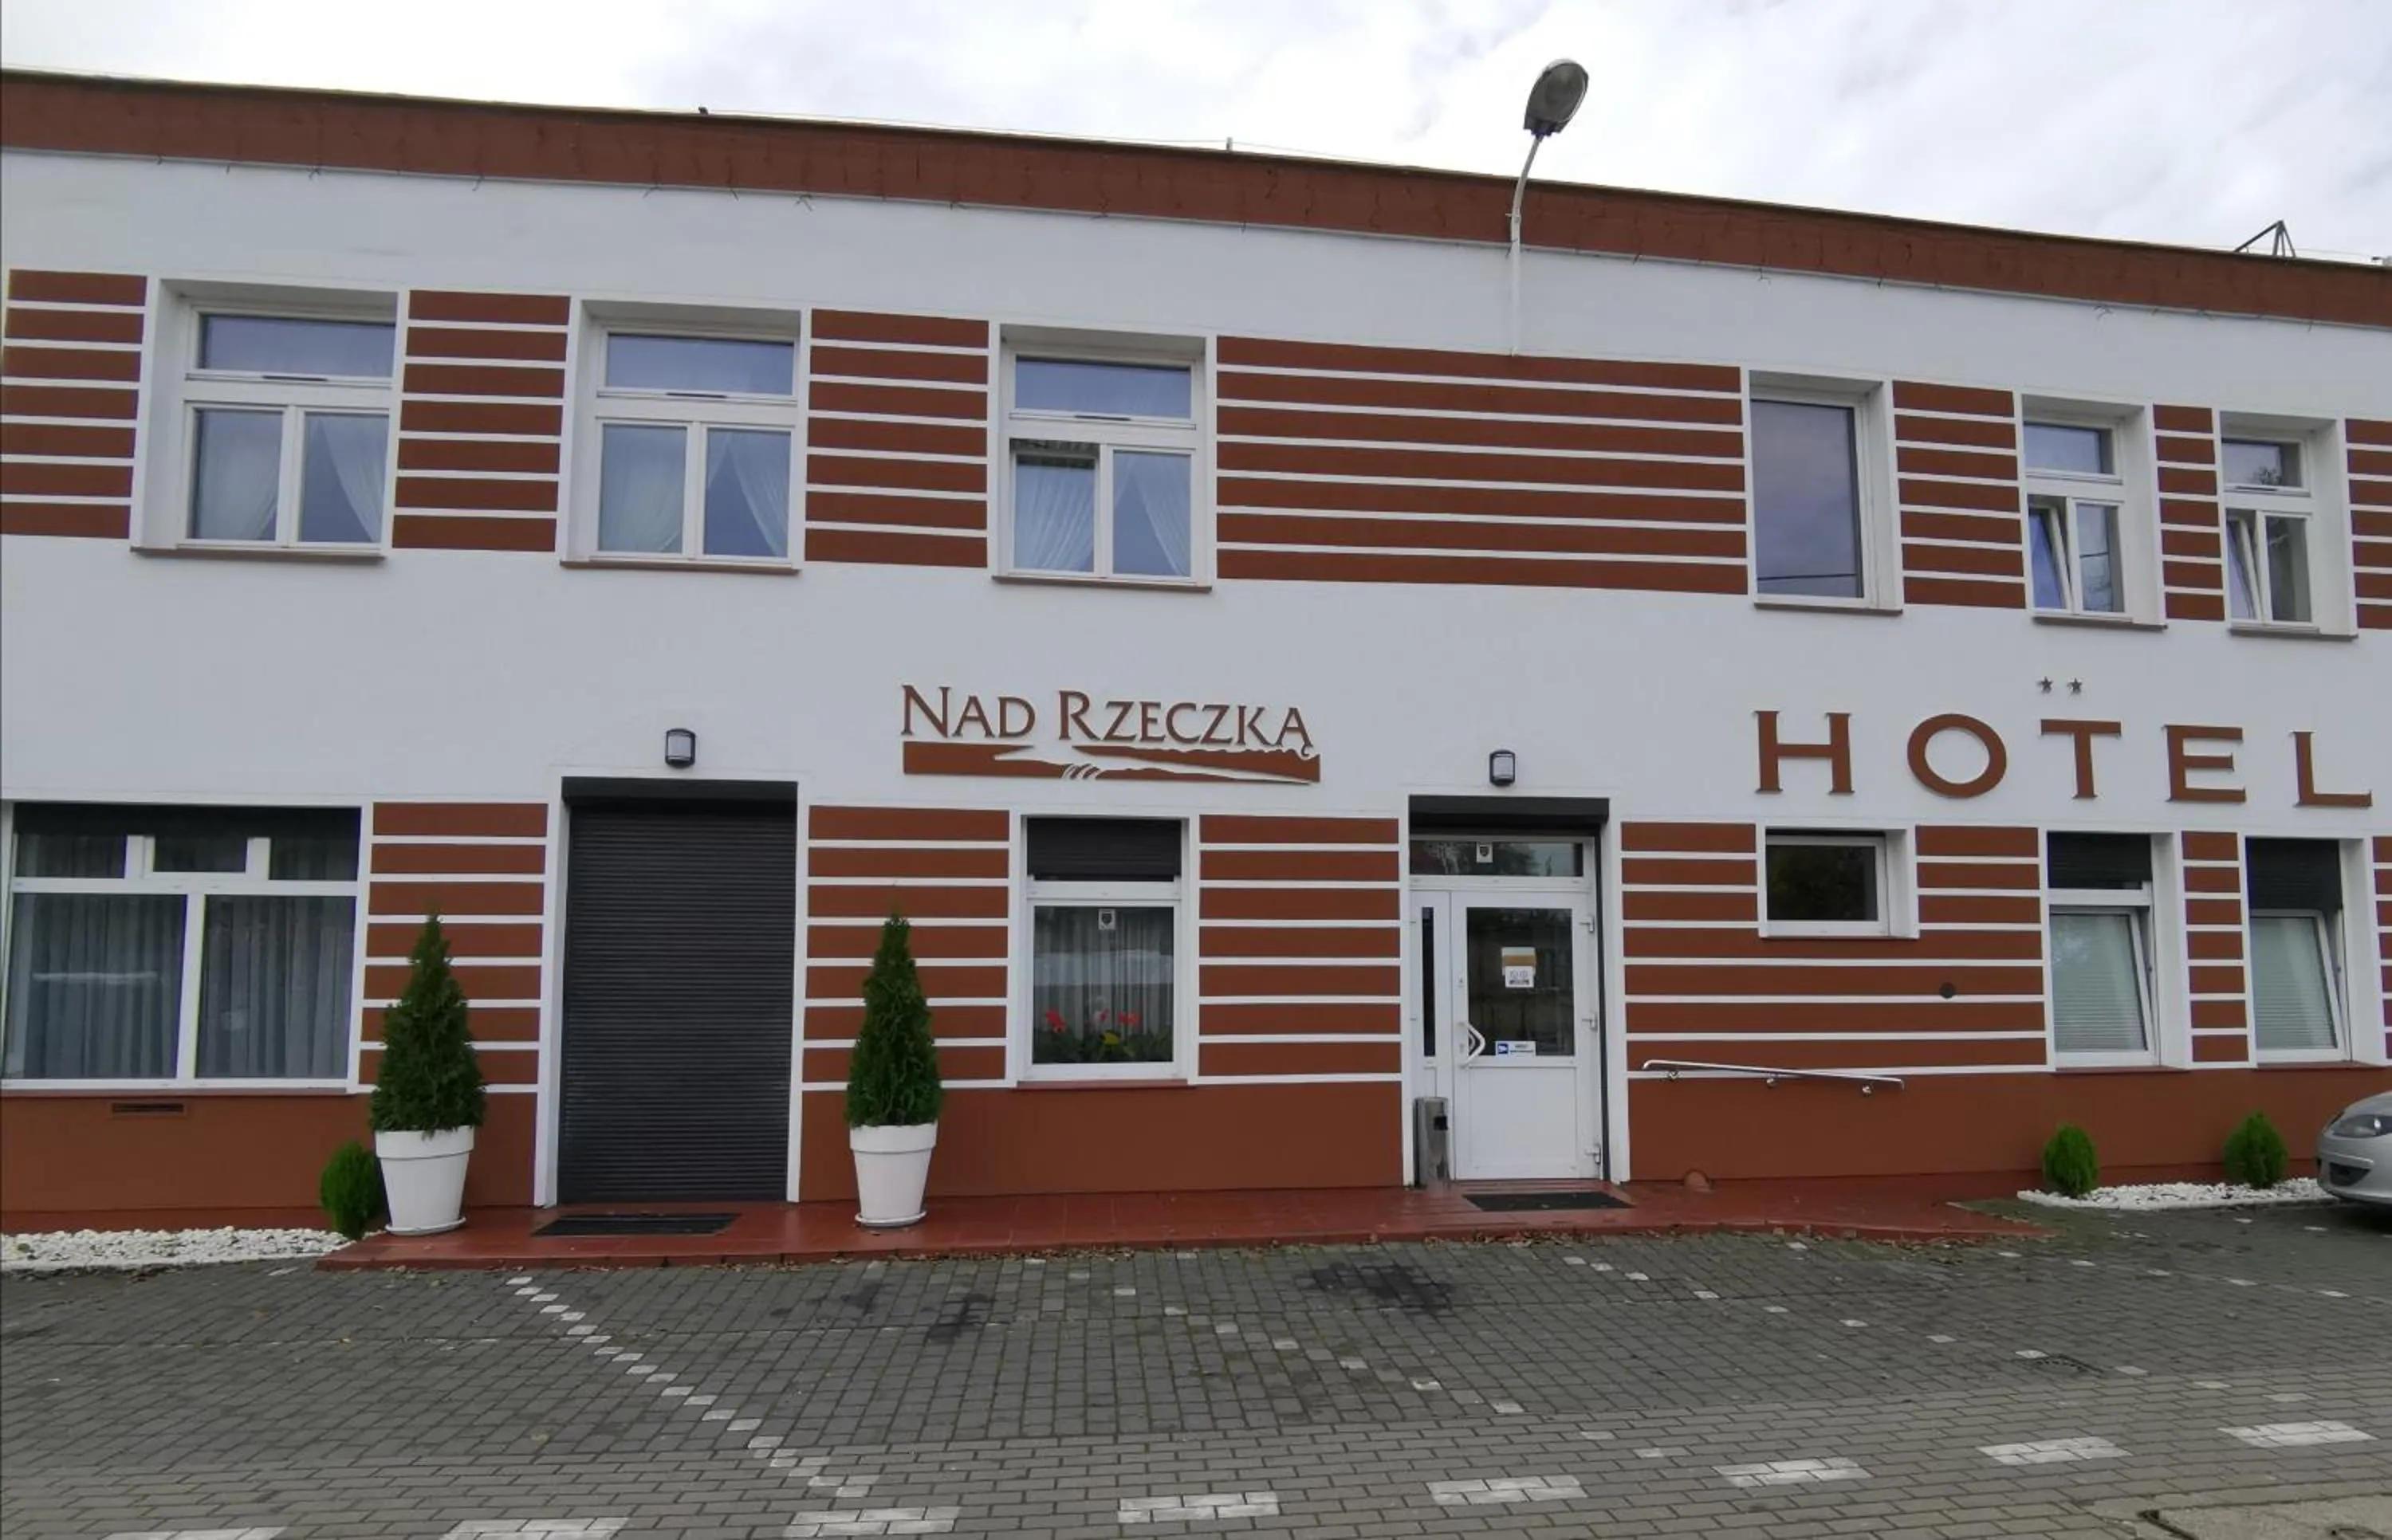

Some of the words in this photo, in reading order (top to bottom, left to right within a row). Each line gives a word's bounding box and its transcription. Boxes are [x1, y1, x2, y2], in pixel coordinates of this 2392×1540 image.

[901, 685, 1037, 739] NAD
[1057, 690, 1314, 756] RZECZKĄ
[1754, 709, 2374, 808] HOTEL
